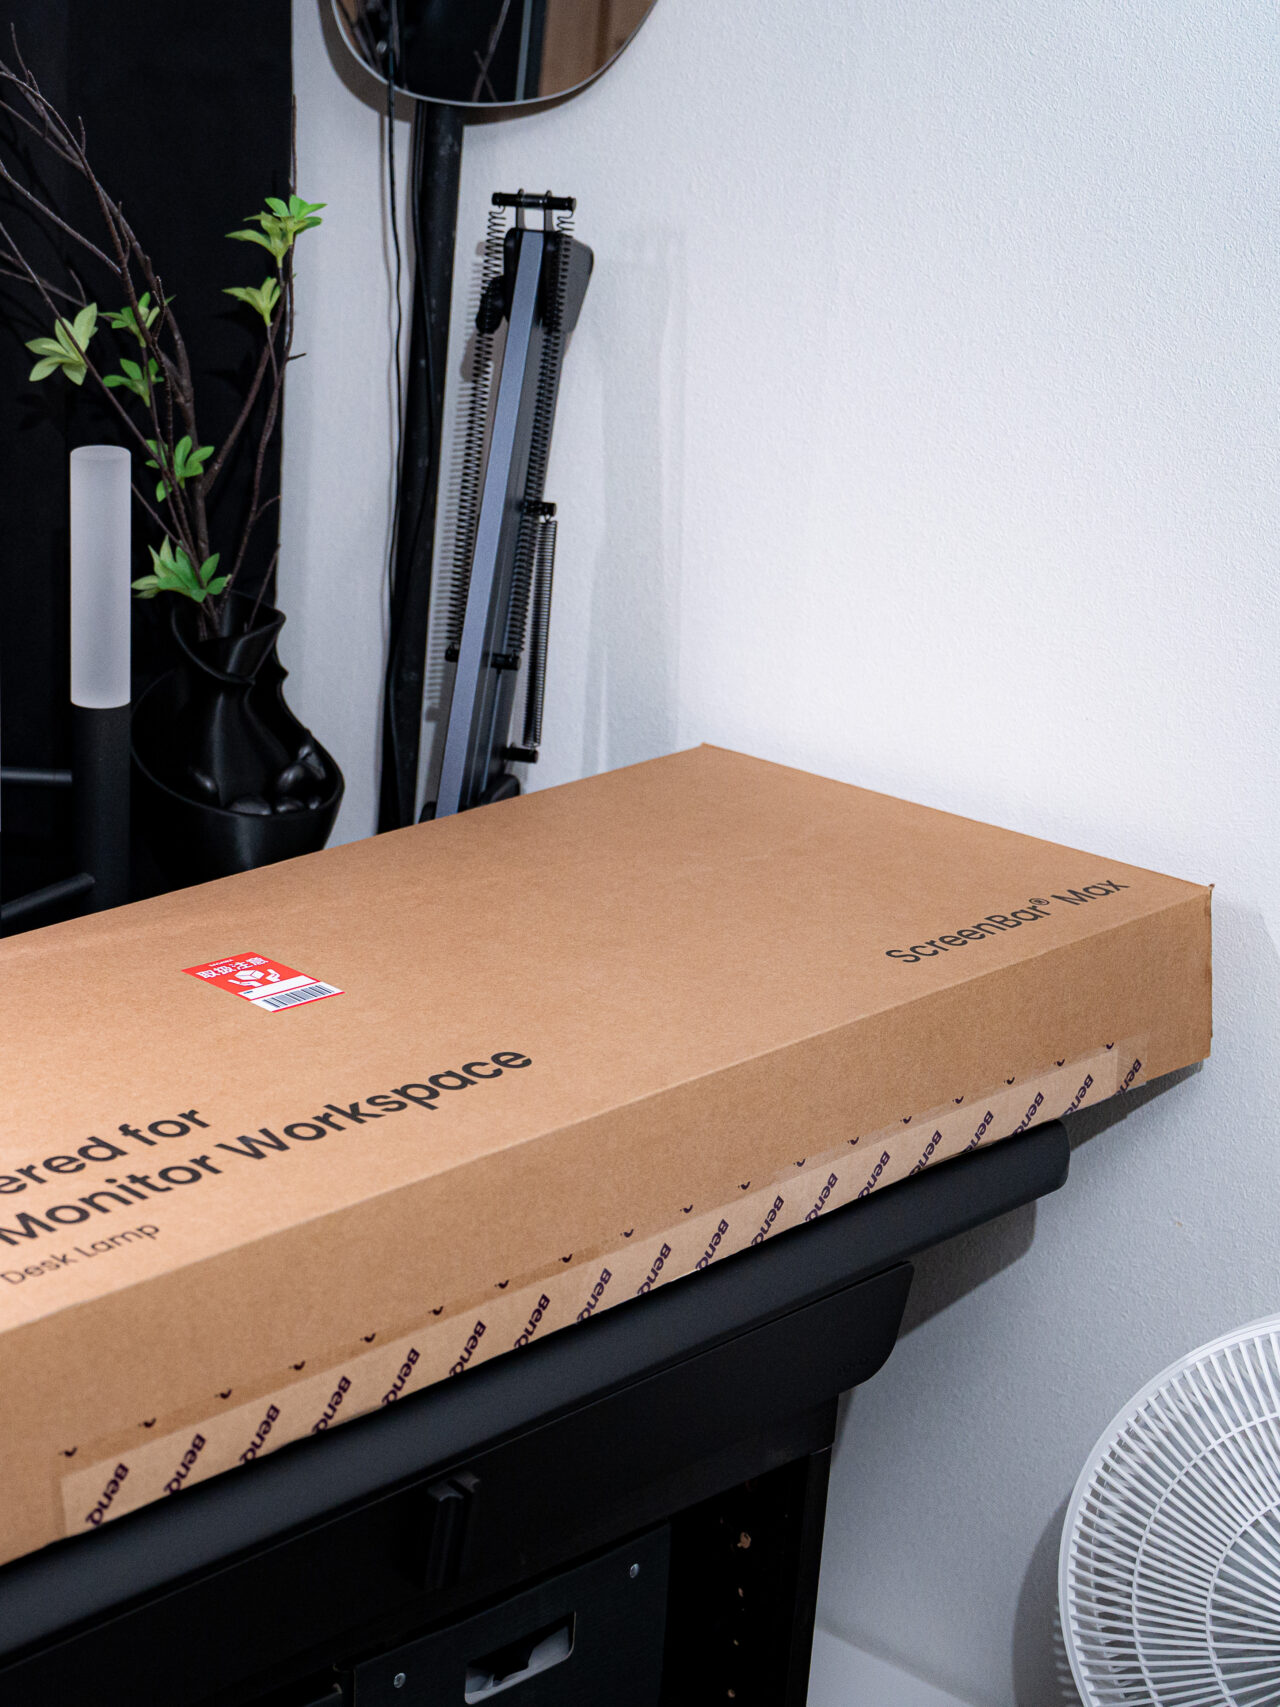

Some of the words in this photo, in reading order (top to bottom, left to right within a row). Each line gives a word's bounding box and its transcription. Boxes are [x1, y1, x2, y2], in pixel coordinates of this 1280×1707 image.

[1051, 879, 1130, 906] Max
[214, 1051, 533, 1160] Workspace
[1115, 1058, 1142, 1094] Ben
[117, 1109, 211, 1147] for
[963, 1110, 994, 1151] Ben
[0, 1252, 78, 1286] Desk
[73, 1224, 160, 1259] Lamp
[163, 1433, 207, 1494] BenQ
[239, 1404, 281, 1464] BenQ
[85, 1462, 130, 1527] BenQ
